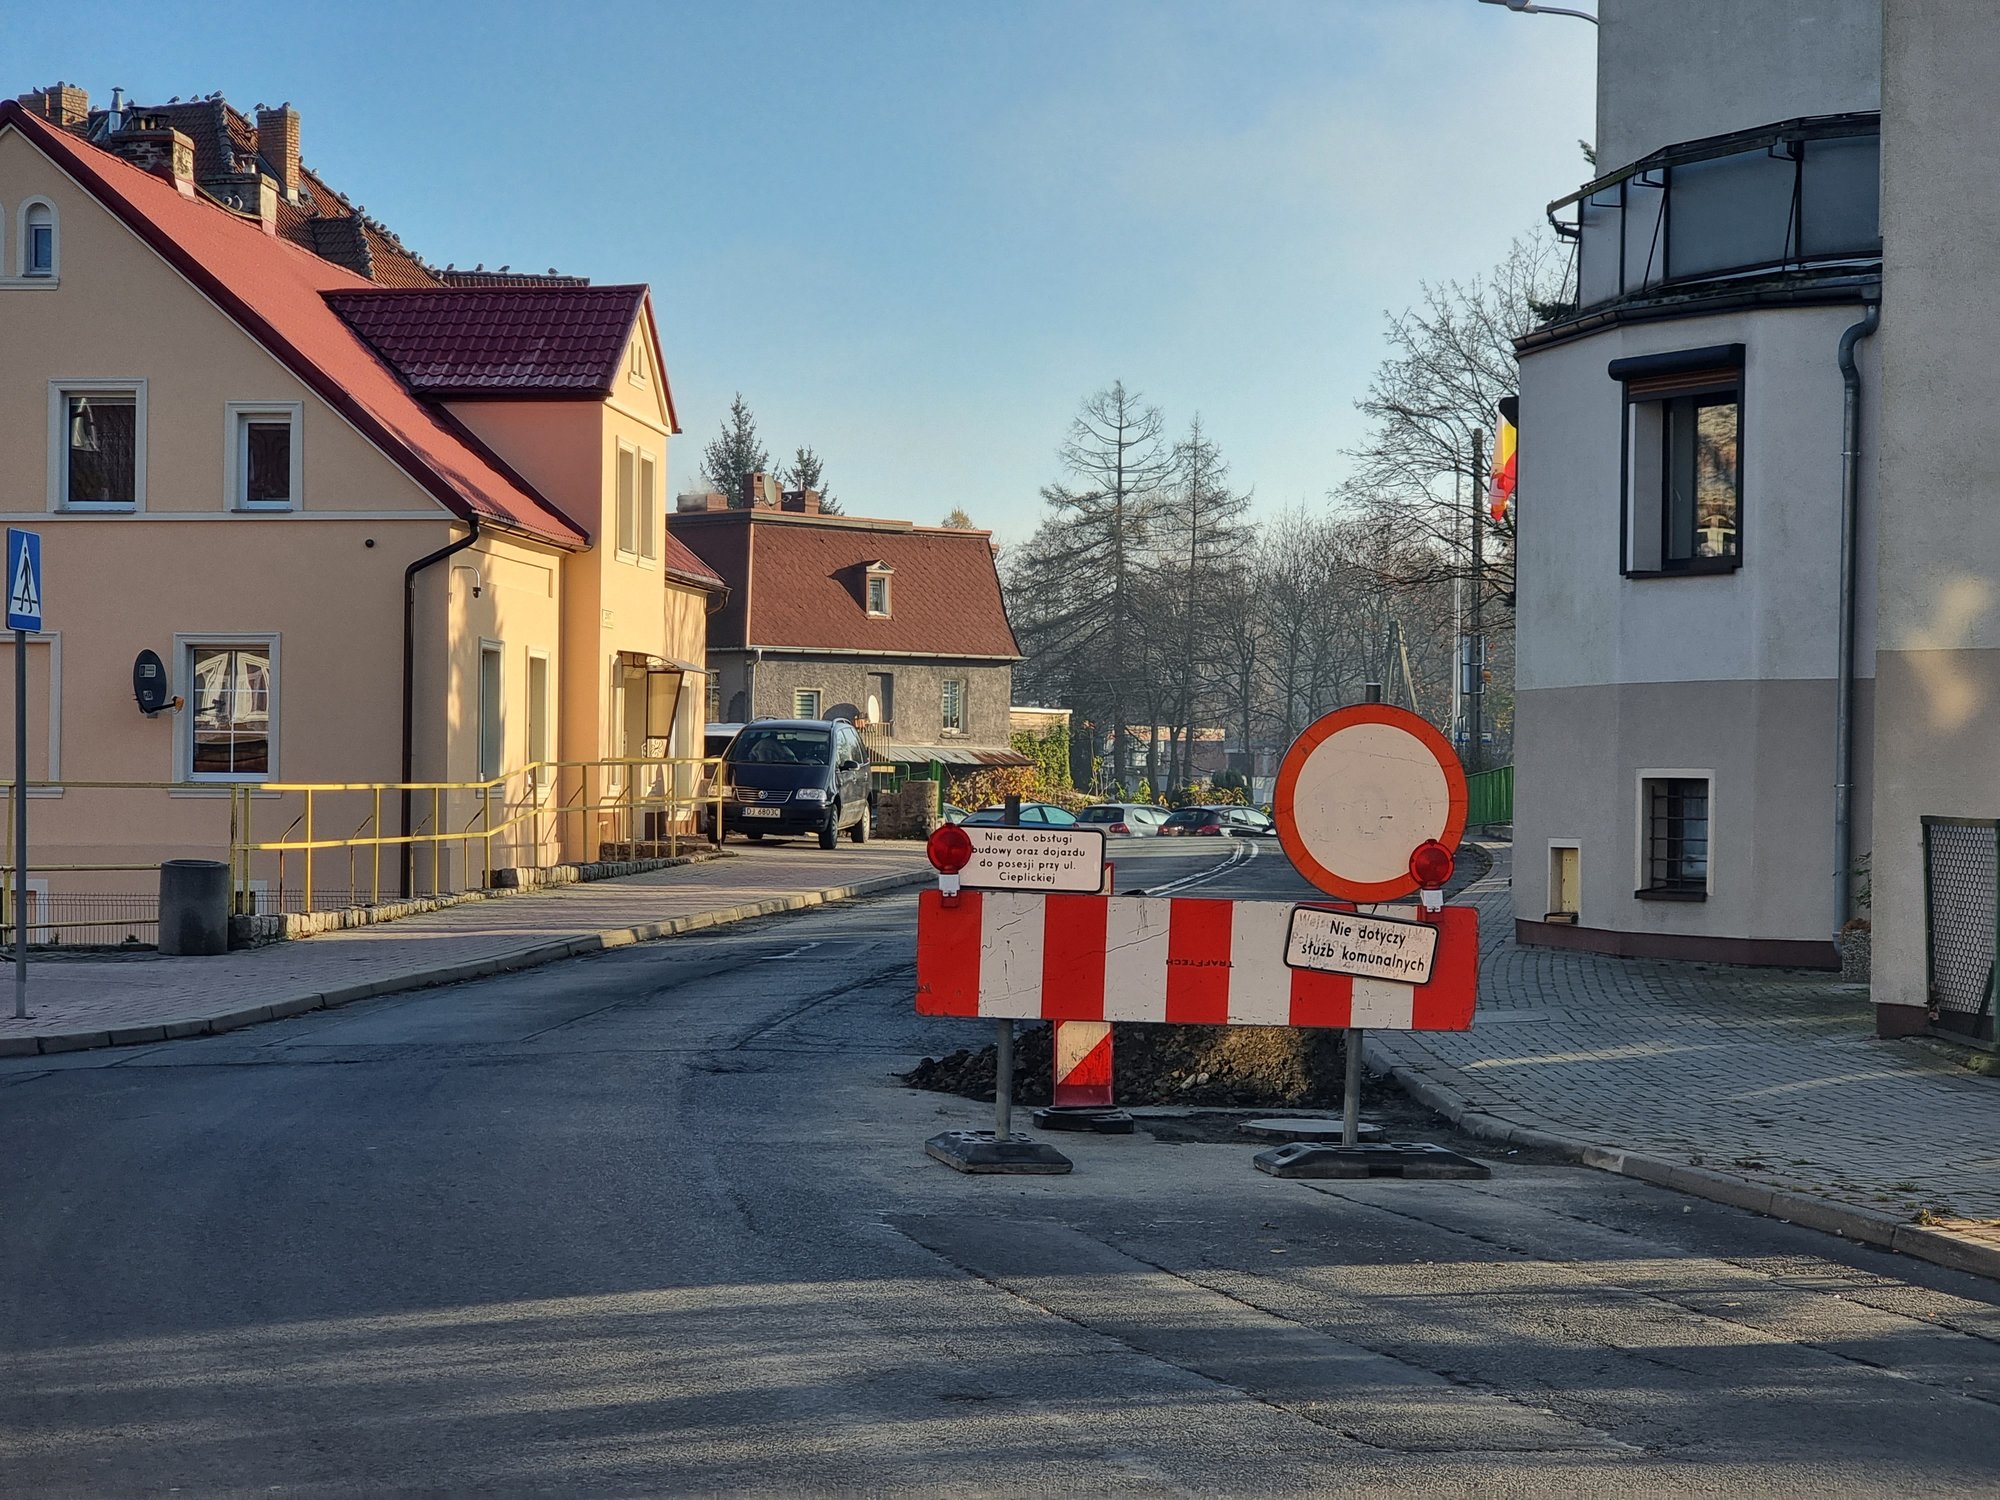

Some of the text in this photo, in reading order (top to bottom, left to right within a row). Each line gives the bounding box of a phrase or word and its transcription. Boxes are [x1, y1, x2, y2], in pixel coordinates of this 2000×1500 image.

[985, 832, 1073, 845] Nie dot. obsługi
[971, 846, 1012, 857] budowy
[1043, 848, 1086, 858] dojazdu
[979, 859, 1076, 873] do posesji przy ul.
[999, 871, 1056, 884] Cieplickiej
[1329, 920, 1352, 937] Nie
[1358, 925, 1406, 949] dotyczy
[1301, 941, 1335, 958] służb
[1341, 946, 1425, 973] komunalnych
